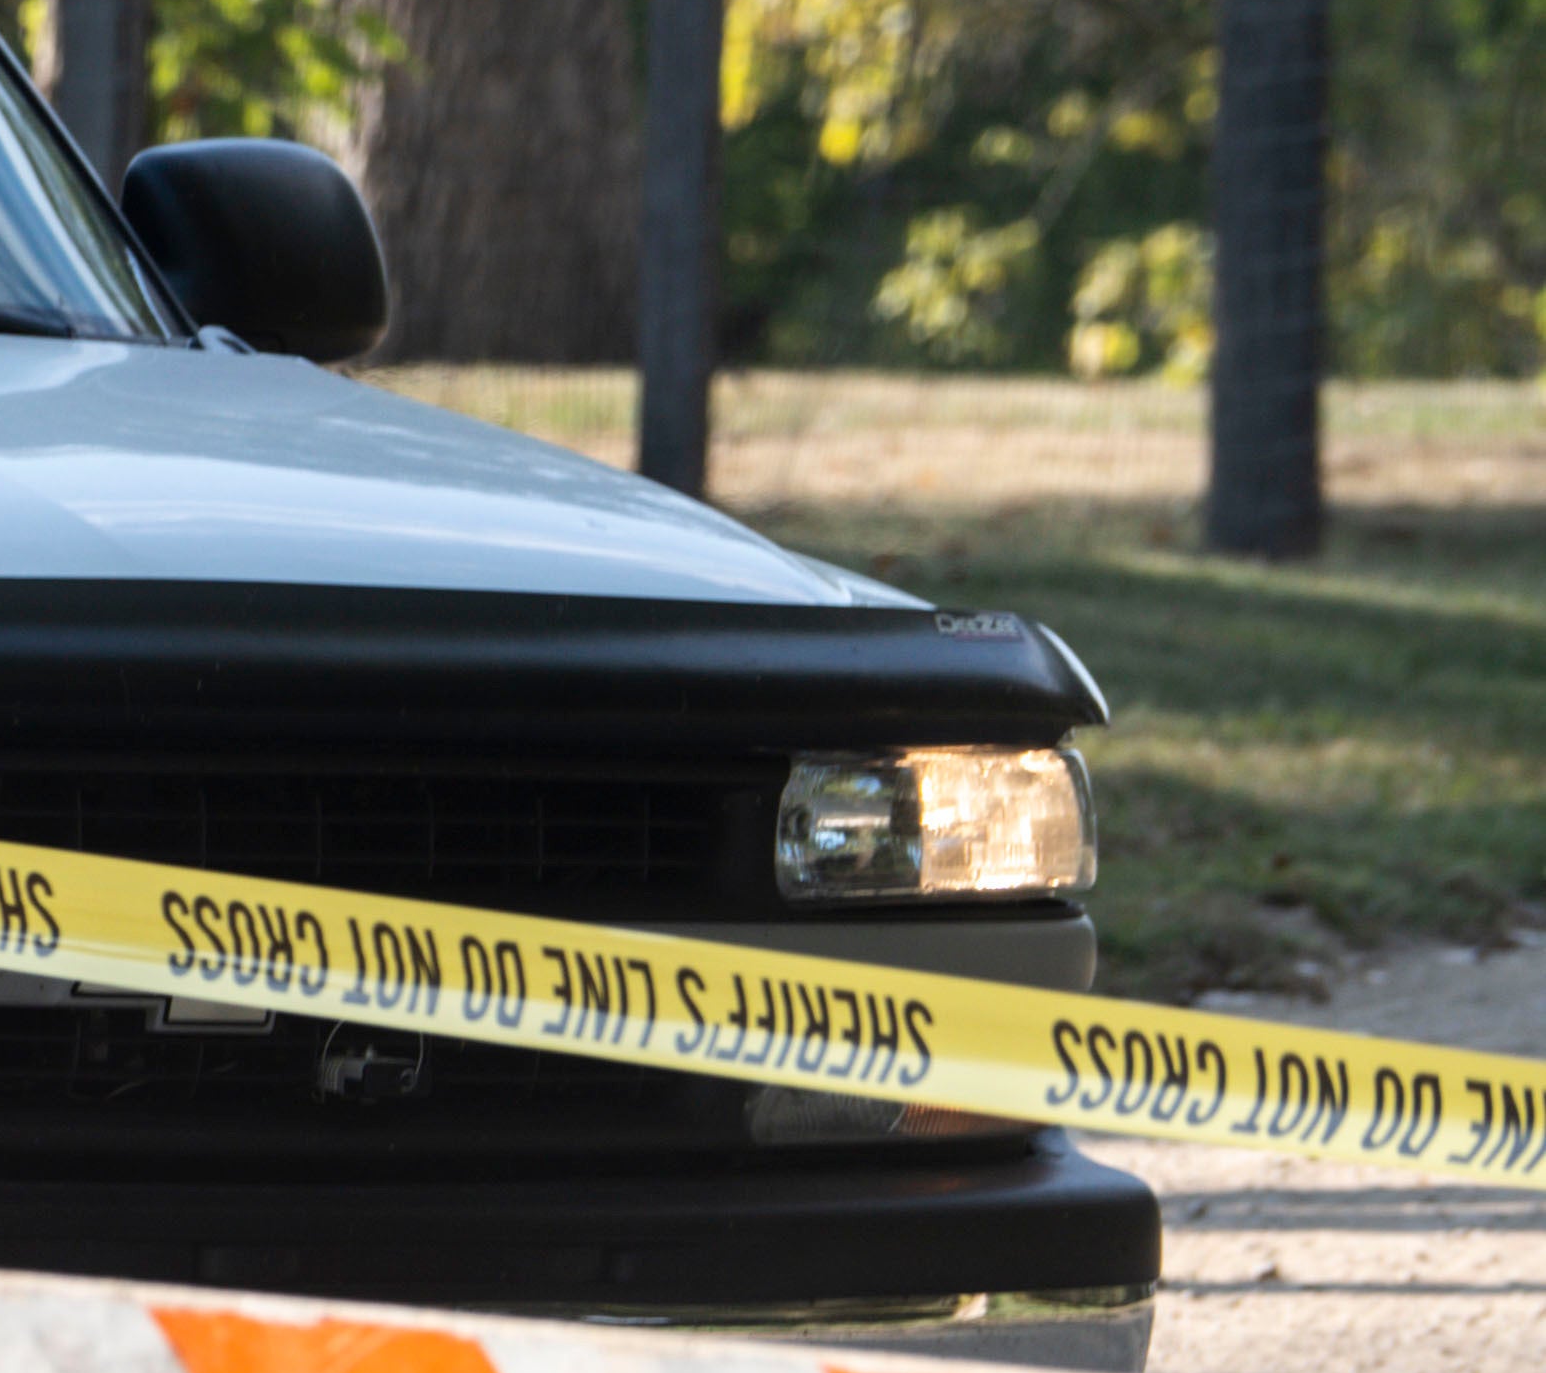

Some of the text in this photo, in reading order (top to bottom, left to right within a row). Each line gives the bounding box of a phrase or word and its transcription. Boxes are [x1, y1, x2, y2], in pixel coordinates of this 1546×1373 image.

[160, 889, 933, 1085] SHERIFF'S LINE DO NOT CROSS
[1046, 1018, 1228, 1124] CROSS
[1232, 1046, 1350, 1142] NOT
[1361, 1065, 1442, 1156] DO
